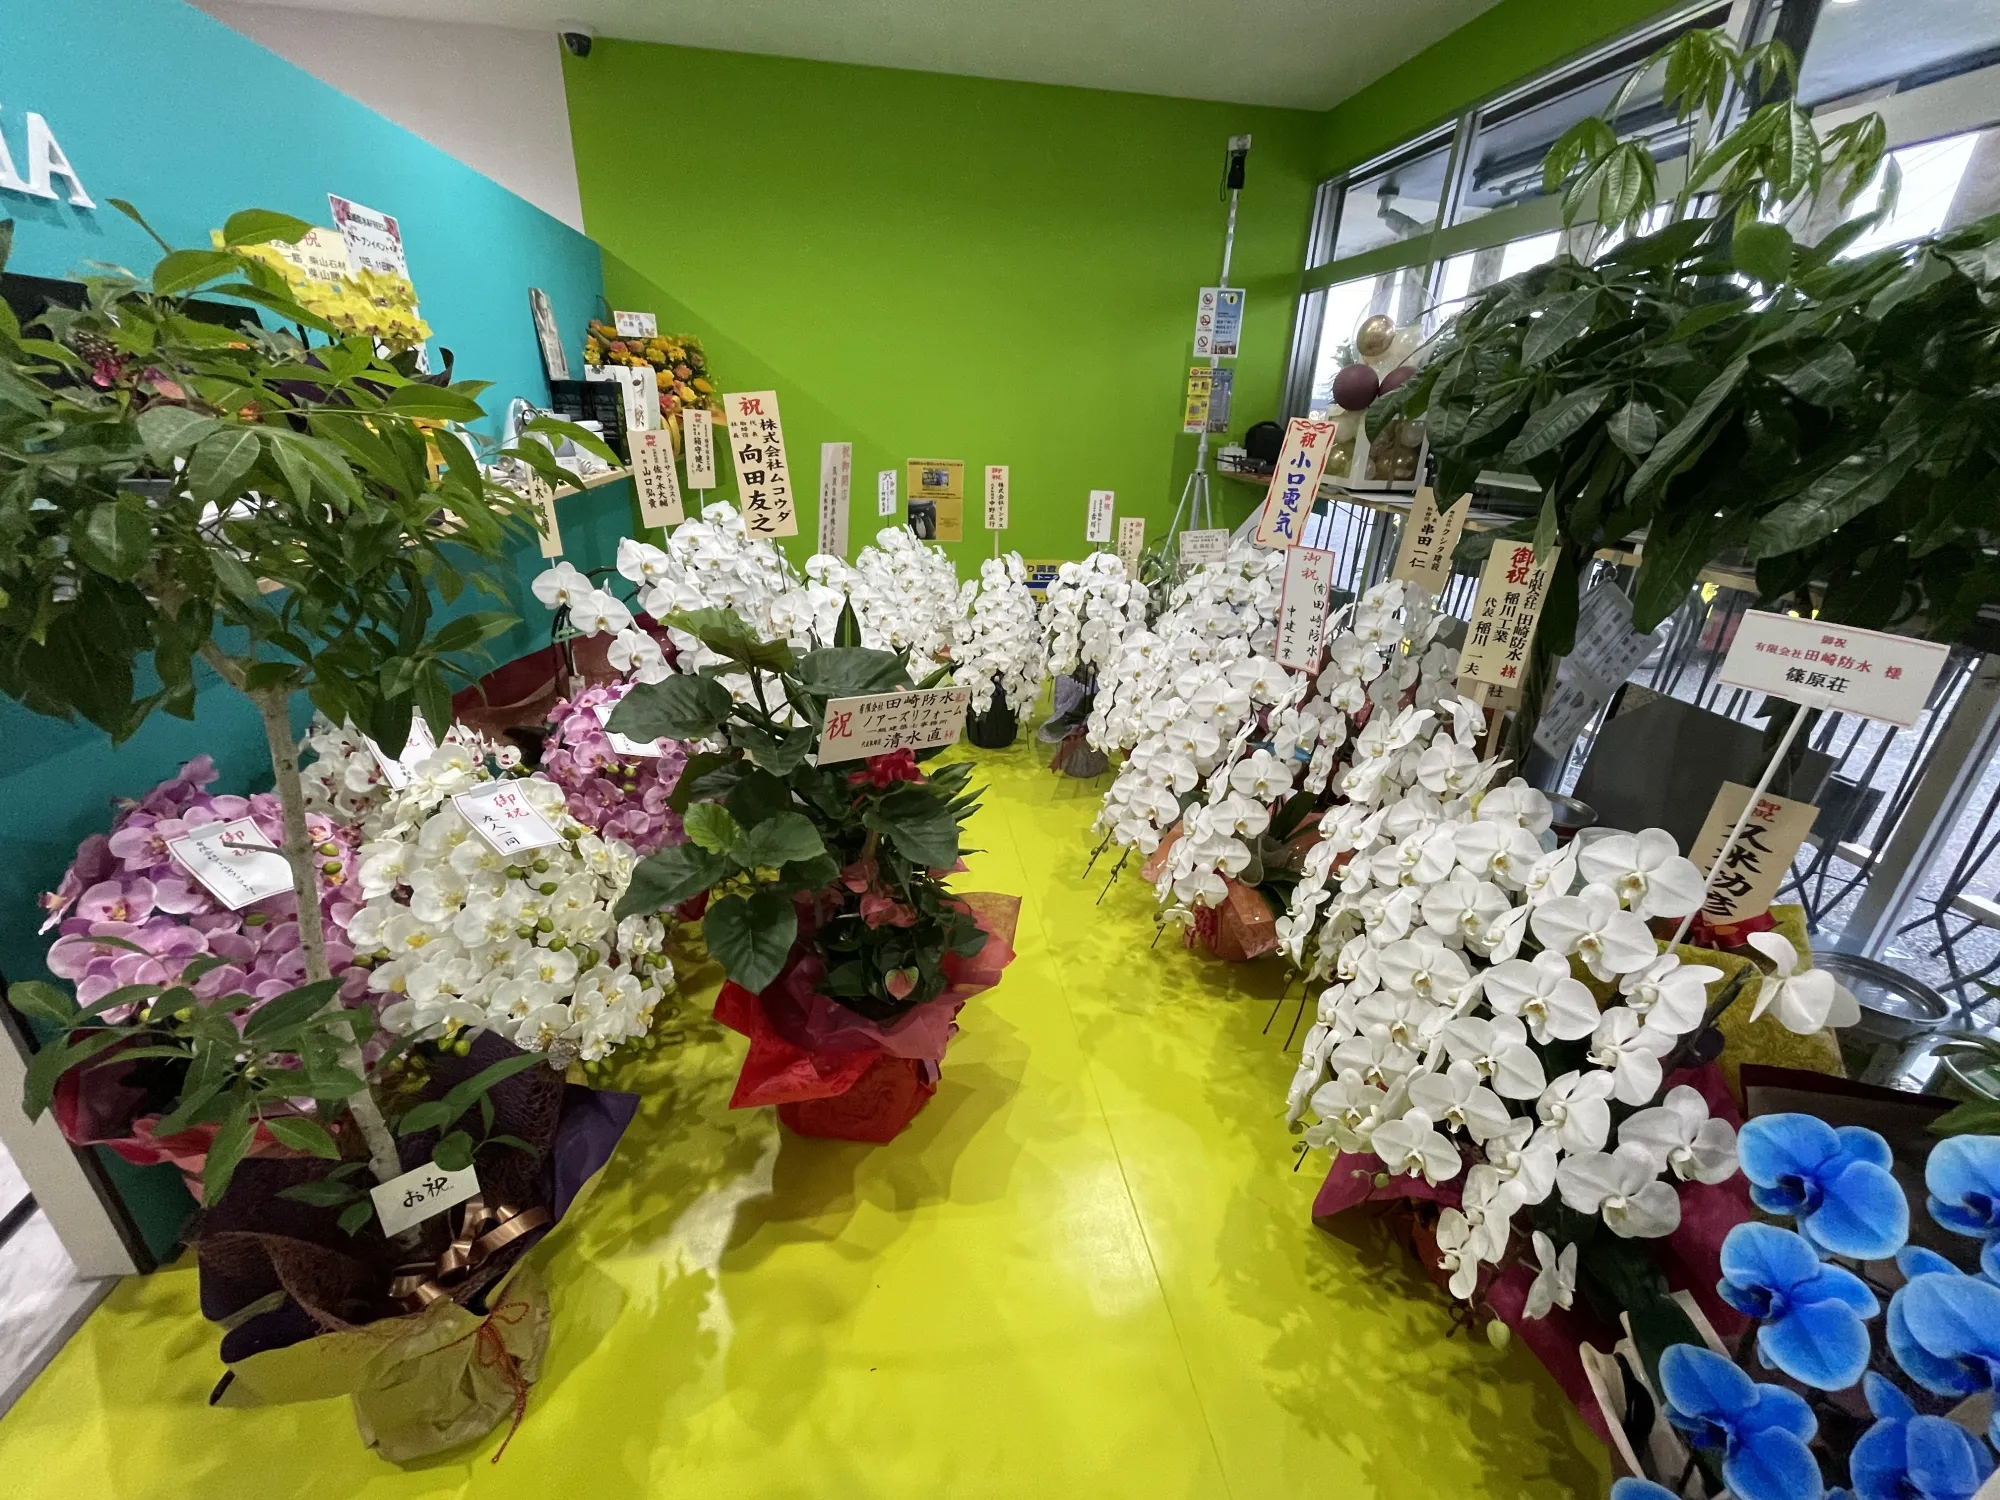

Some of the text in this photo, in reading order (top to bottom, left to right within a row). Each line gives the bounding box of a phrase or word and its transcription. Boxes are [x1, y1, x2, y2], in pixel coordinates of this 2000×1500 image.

[739, 397, 764, 416] 祝
[1300, 432, 1317, 448] 祝
[760, 418, 791, 522] 株式会社ムコウダ
[739, 443, 776, 532] 向田友之
[1273, 451, 1311, 539] 小口電気
[1409, 523, 1435, 568] 串田一仁
[1302, 552, 1321, 580] 御祝
[1505, 546, 1536, 585] 御祝
[1282, 605, 1296, 660] 中建工業
[1492, 592, 1520, 643] 稲川工業
[1500, 569, 1547, 678] 有限会社 田崎防水 様
[1463, 597, 1497, 676] 代表 稲川 一夫
[1821, 634, 1847, 649] 御祝
[1755, 641, 1903, 680] 有限会社田崎防水 様
[1785, 666, 1851, 693] 篠原荘
[826, 711, 852, 741] 祝
[863, 705, 962, 728] ノアーズリフォーム
[884, 728, 941, 748] 清水直
[494, 793, 529, 819] 御祝
[484, 815, 521, 847] 友人一同
[403, 1176, 454, 1208] お祝
